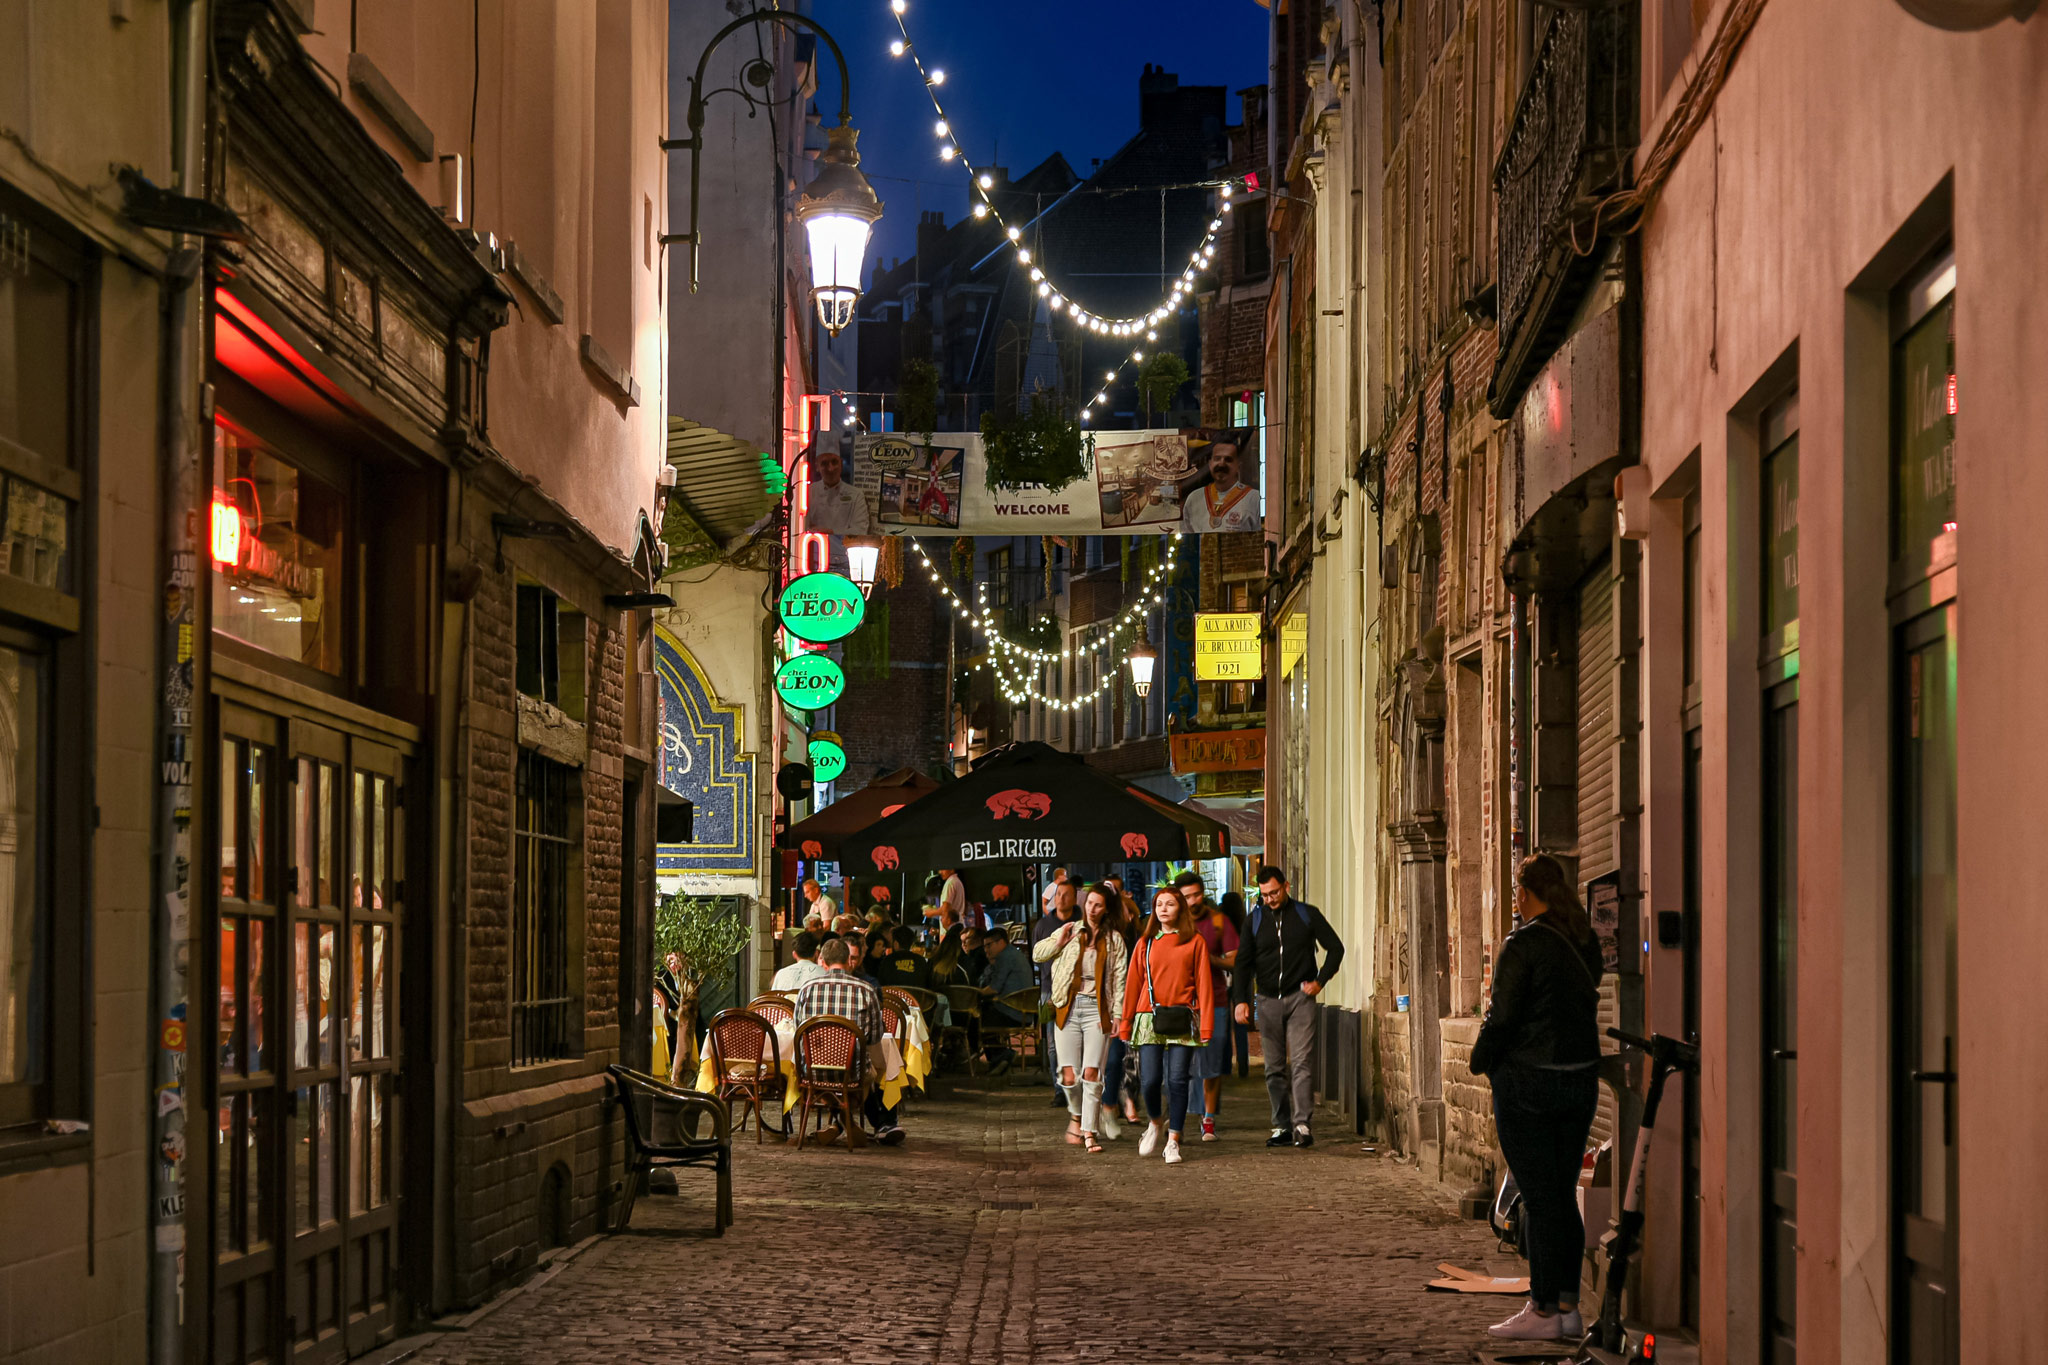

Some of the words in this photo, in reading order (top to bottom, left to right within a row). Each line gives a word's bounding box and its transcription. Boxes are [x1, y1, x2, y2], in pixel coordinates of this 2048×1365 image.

[874, 447, 912, 457] LEON
[994, 503, 1070, 516] WELCOME
[793, 591, 819, 599] chez
[784, 598, 858, 617] LEON
[1204, 620, 1219, 631] AUX
[1225, 620, 1253, 631] ARMES
[1197, 640, 1207, 653] DE
[1211, 640, 1260, 652] BRUXELLES
[1217, 663, 1240, 675] 1921
[780, 675, 839, 690] LEON
[810, 756, 842, 767] EON
[960, 839, 1057, 861] DELIRIUM
